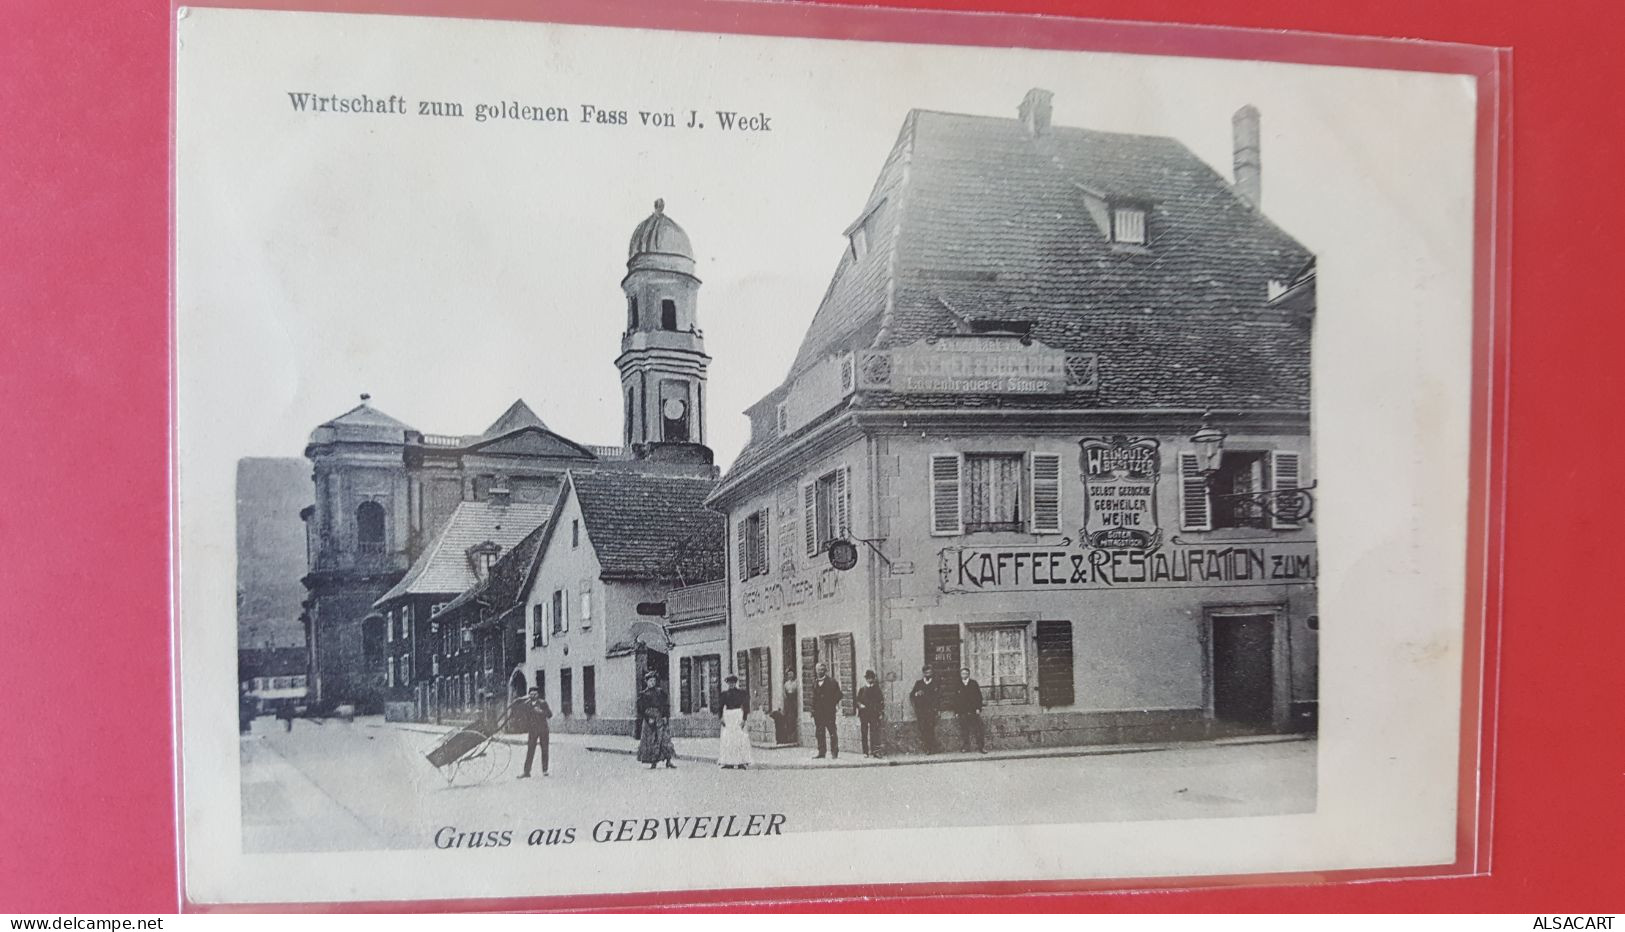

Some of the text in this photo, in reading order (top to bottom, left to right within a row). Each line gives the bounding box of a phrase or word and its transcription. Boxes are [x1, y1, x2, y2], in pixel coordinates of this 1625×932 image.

[288, 92, 772, 131] Wirtschaft zum goldenen Fass von J. Weck
[957, 551, 1067, 588] KAFFEE
[434, 813, 787, 850] Gruss aus GEBWEILER
